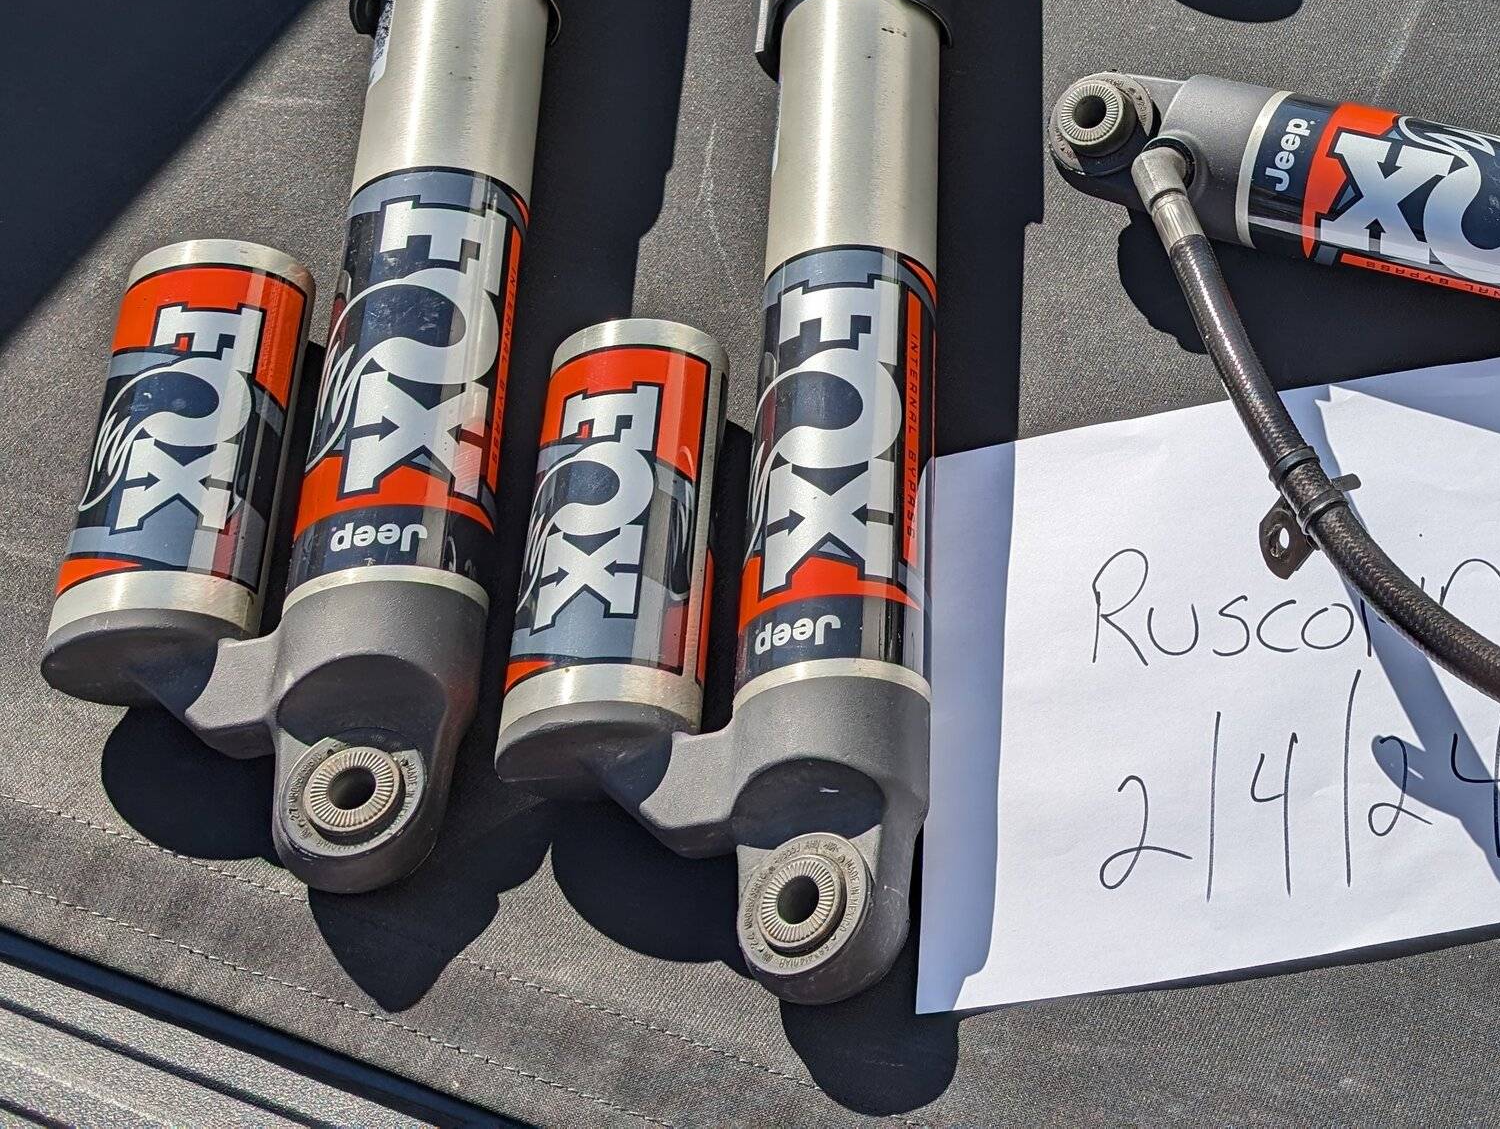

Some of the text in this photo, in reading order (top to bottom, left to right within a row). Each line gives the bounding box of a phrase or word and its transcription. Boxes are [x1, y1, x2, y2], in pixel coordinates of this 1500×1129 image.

[1265, 118, 1311, 192] Jeep
[501, 267, 516, 361] INTERNAL
[1366, 261, 1450, 286] BYPASS
[305, 201, 507, 500] FOX
[79, 305, 263, 530] FOX
[743, 279, 901, 595] FOX
[906, 333, 918, 539] INTERNAL BYPASS
[330, 522, 427, 552] Jeep
[516, 385, 660, 631] FOX
[755, 614, 841, 656] Jeep
[846, 859, 860, 883] MADE
